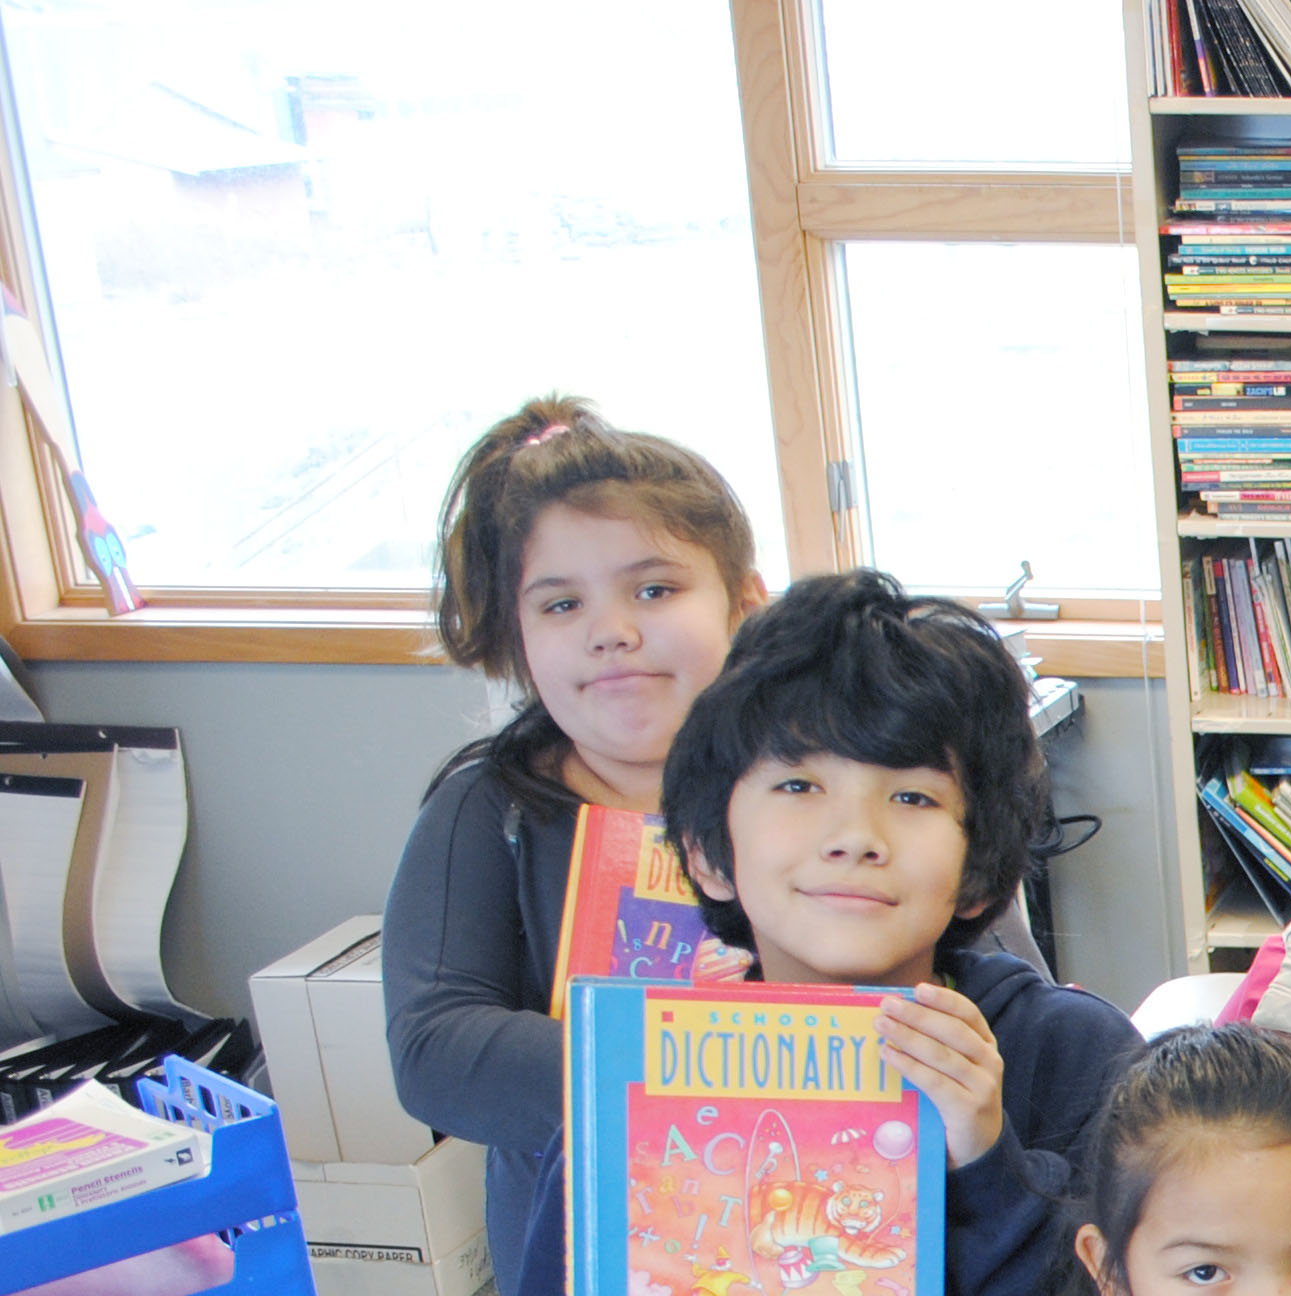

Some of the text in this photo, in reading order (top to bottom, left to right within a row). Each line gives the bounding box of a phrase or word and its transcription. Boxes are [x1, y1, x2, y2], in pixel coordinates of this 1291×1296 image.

[709, 1010, 840, 1028] SCHOOL
[660, 1029, 865, 1092] DICTIONARY
[72, 1179, 101, 1194] Pencil
